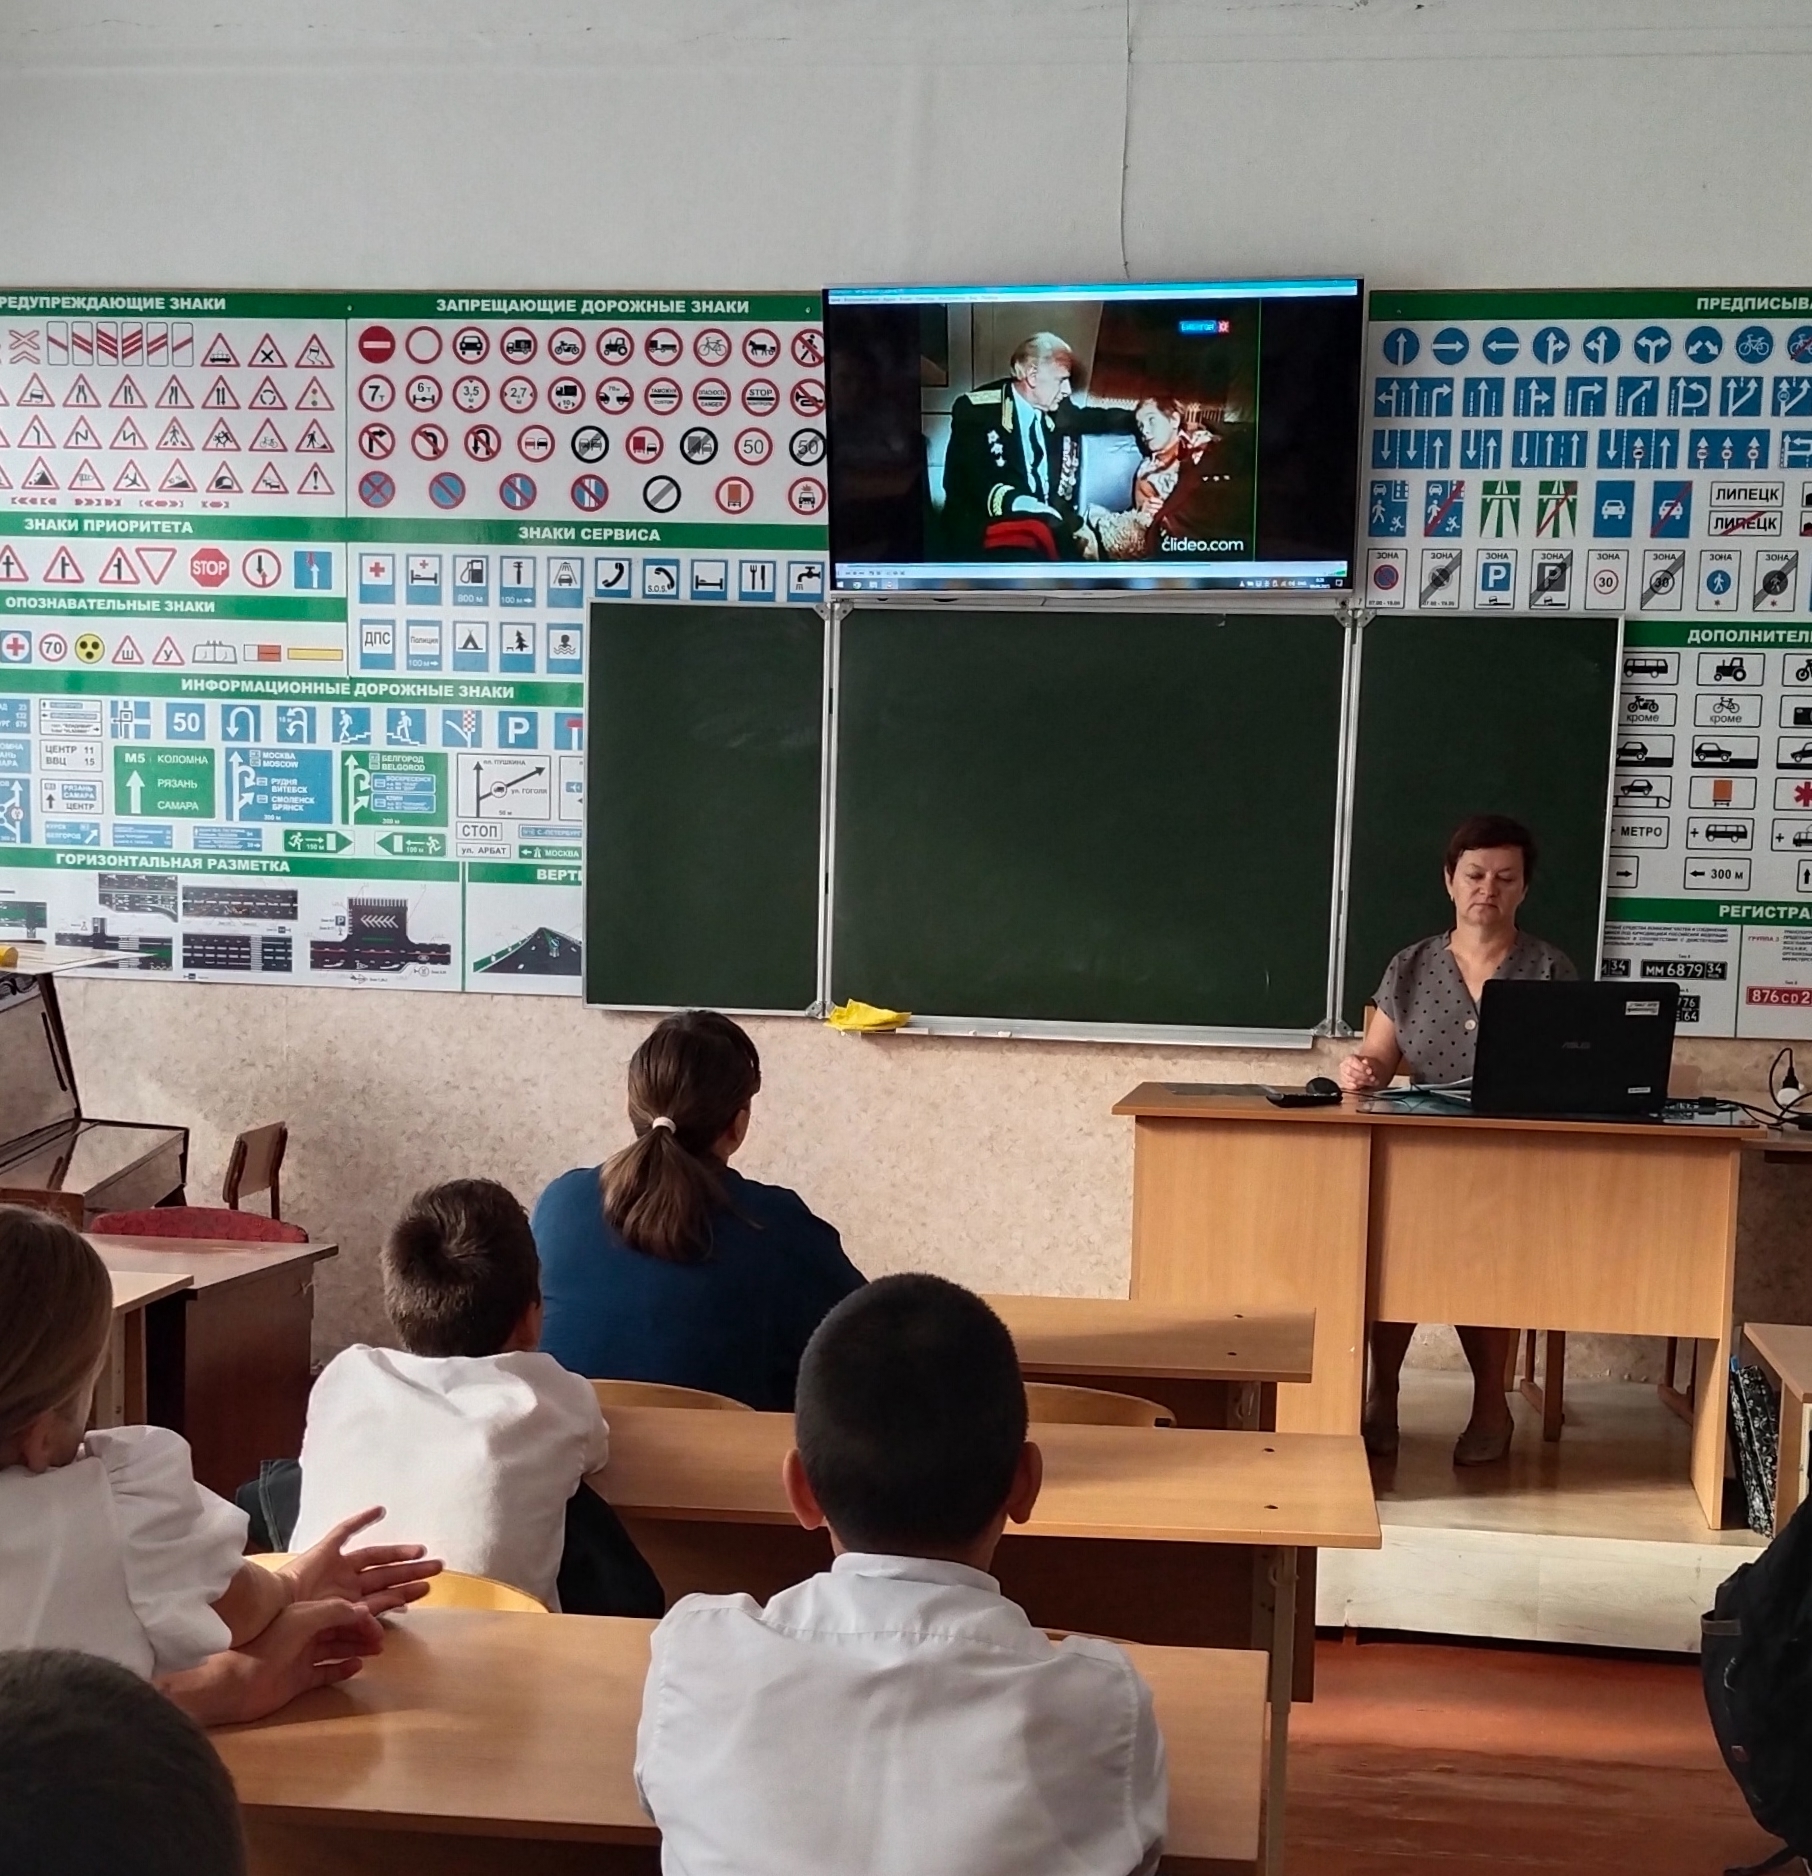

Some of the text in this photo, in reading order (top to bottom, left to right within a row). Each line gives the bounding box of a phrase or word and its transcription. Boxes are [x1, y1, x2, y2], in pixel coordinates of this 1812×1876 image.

[169, 297, 226, 310] ЗНАКИ
[436, 299, 749, 314] ЗАПРЕЩАЮЩИЕ ДОРОЖНЫЕ ЗНАКИ
[1697, 297, 1812, 312] ПРЕДПИСЫВ
[463, 386, 480, 397] 3,5
[510, 387, 527, 399] 2,7
[749, 389, 772, 397] STOP
[743, 440, 764, 454] 50
[798, 440, 818, 454] 50
[1716, 488, 1780, 502] ЛИПЕЦК
[24, 518, 193, 533] ЗНАКИ ПРИОРИТЕТА
[1714, 517, 1777, 530] ЛИПЕЦК
[518, 527, 661, 541] ЗНАКИ СЕРВИСА
[1161, 537, 1244, 551] clideo.com
[192, 558, 227, 576] STOP
[1598, 577, 1613, 588] 30
[6, 597, 215, 613] ОПОЗНАВАТЕЛЬНЫЕ ЗНАКИ
[364, 632, 391, 647] ДПС
[410, 636, 438, 645] Полиция
[1687, 629, 1812, 644] ДОПОЛНИТЕЛ
[44, 641, 62, 654] 70
[181, 678, 514, 698] ИНФОРМАЦИОННЫЕ ДОРОЖНЫЕ ЗНАКИ
[173, 713, 200, 732] 50
[1626, 714, 1659, 723] кроме
[1710, 715, 1742, 724] кроме
[508, 717, 530, 743] P
[45, 745, 94, 754] ЦЕНТР 11
[46, 757, 95, 766] ВВЦ 15
[157, 754, 208, 765] КОЛОМНА
[262, 752, 296, 760] МОСКВА
[382, 755, 425, 763] БЕЛГОРОД
[262, 760, 299, 768] MOSCOW
[382, 763, 425, 771] BELGOROD
[157, 779, 198, 789] РЯЗАНЬ
[271, 785, 308, 793] ВИТЕБСК
[271, 796, 315, 804] СМОЛЕНСК
[66, 803, 94, 811] ЦЕНТР
[157, 801, 199, 811] САМАРА
[272, 803, 304, 811] БРЯНСК
[462, 825, 498, 837] СТОП
[1621, 827, 1662, 837] МЕТРО
[478, 847, 507, 855] АРБАТ
[545, 849, 579, 857] МОСКВА
[56, 853, 290, 872] ГОРИЗОНТАЛЬНАЯ РАЗМЕТКА
[1711, 869, 1732, 879] 300
[1707, 962, 1722, 973] 34
[1684, 1011, 1697, 1021] 64
